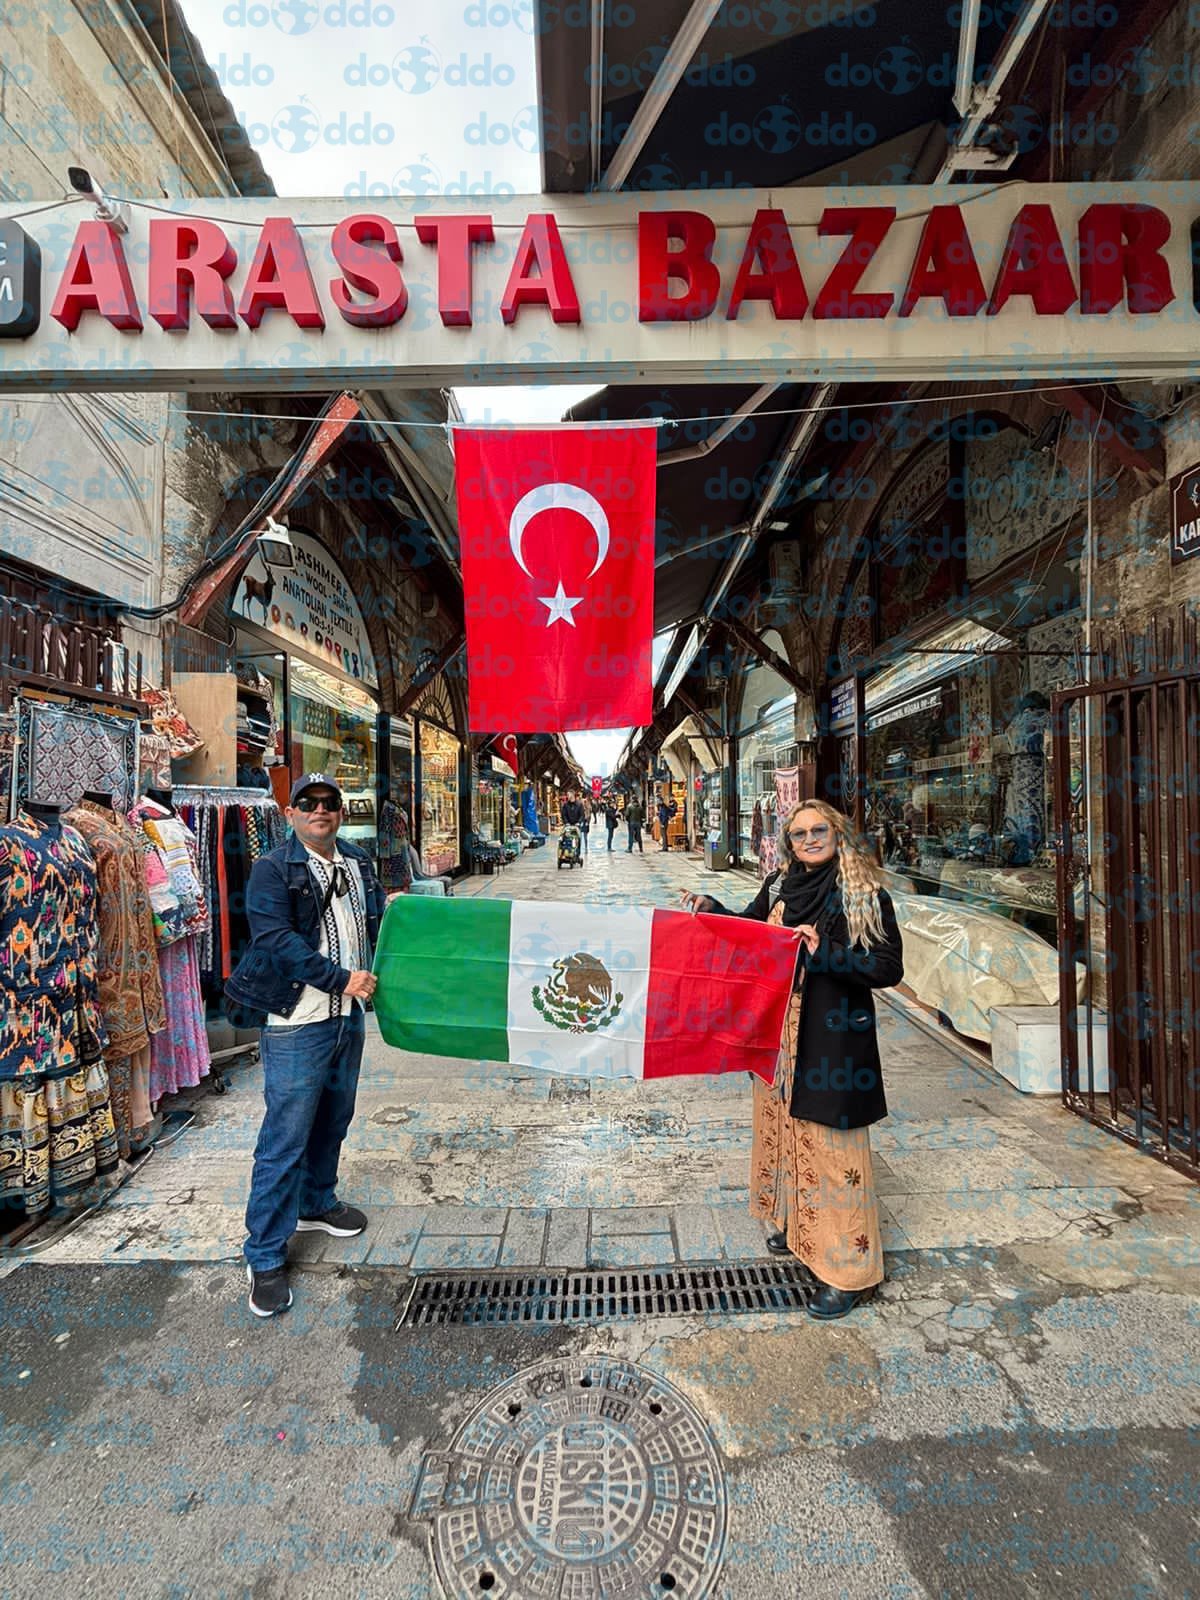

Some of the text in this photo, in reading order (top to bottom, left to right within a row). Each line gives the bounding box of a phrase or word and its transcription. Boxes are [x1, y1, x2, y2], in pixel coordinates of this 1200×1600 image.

[51, 203, 1176, 331] ARASTA BAZAAR
[282, 575, 353, 636] ANATOLIAN TEXTILE
